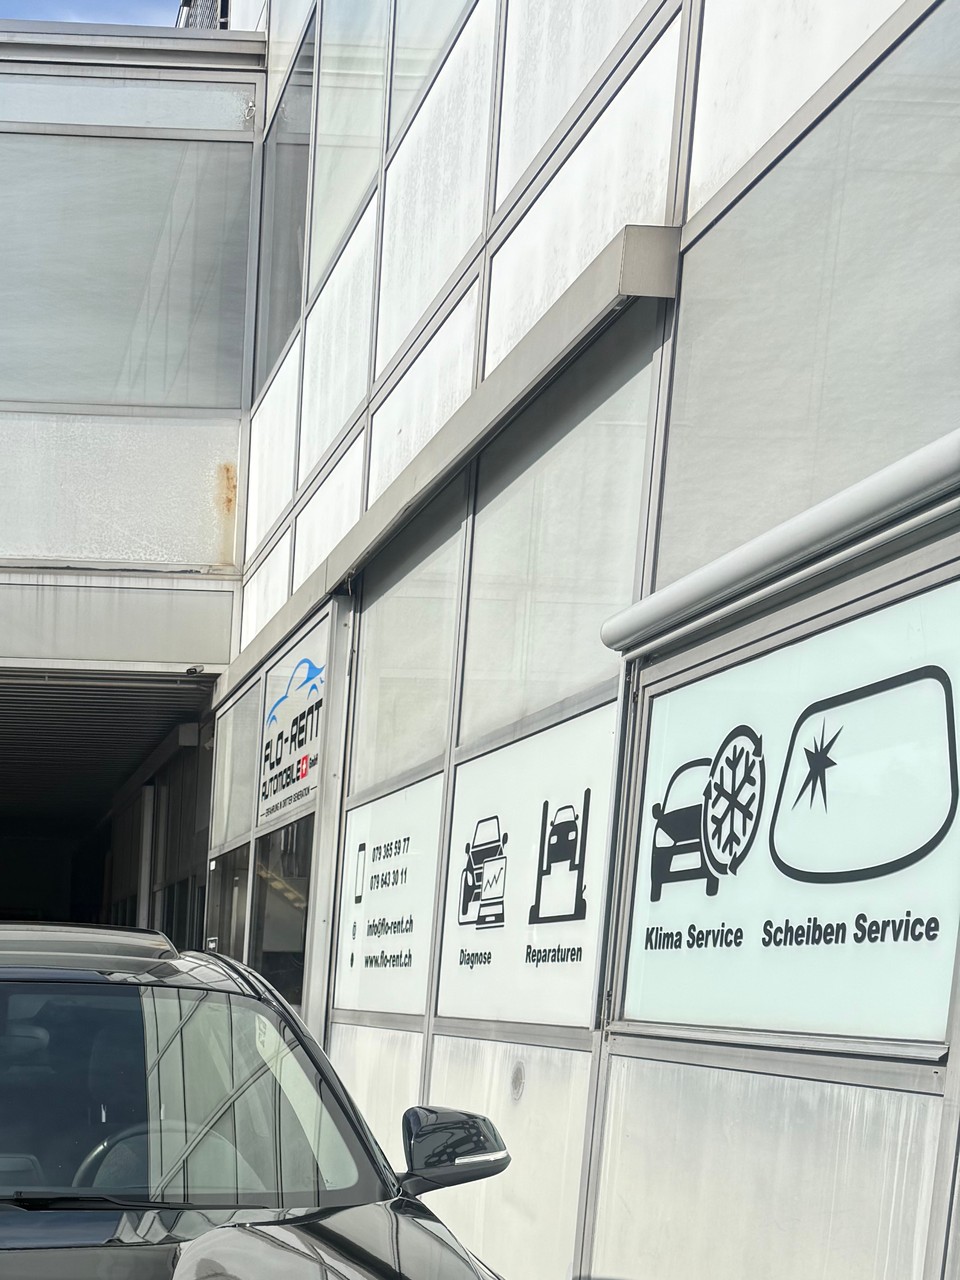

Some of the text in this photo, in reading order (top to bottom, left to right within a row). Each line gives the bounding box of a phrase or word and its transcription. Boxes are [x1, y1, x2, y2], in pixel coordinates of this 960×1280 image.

[263, 698, 323, 776] FLO-RENT
[261, 759, 301, 802] AUTOMOBILE
[372, 836, 410, 862] 079 365 59 77
[370, 867, 408, 891] 079 643 30 11
[367, 914, 413, 938] info@flo-rent.ch
[644, 922, 743, 950] Klima Service
[761, 910, 940, 947] Scheiben Service
[364, 948, 412, 968] www.flo-rent.ch
[459, 948, 492, 970] Diagnose
[525, 943, 583, 968] Reparaturen
